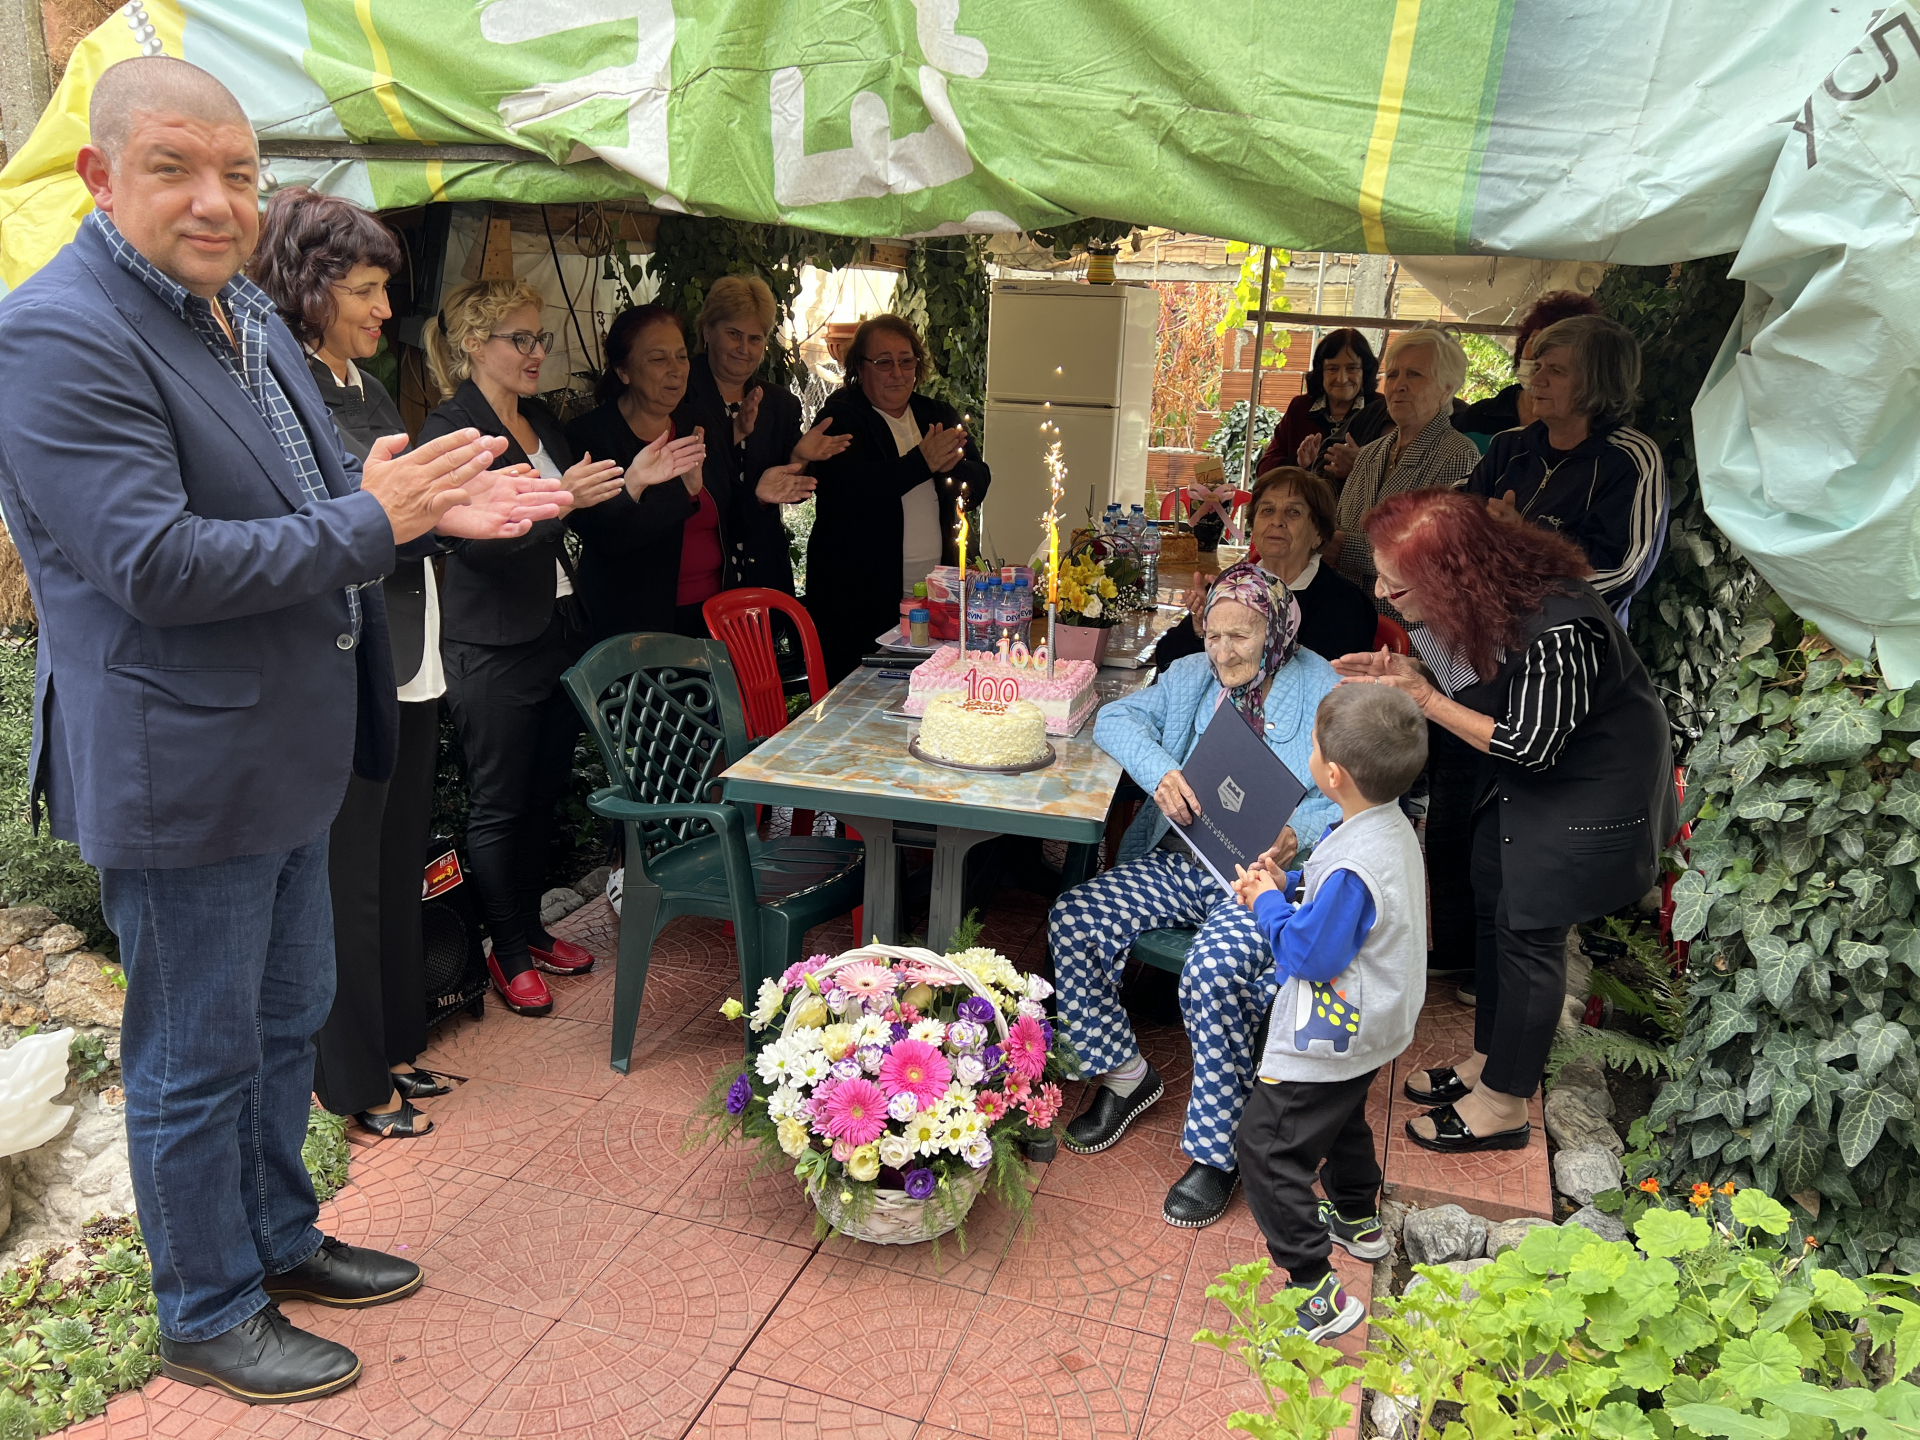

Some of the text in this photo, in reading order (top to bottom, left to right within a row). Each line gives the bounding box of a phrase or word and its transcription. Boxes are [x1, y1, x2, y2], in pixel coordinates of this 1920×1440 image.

[994, 637, 1049, 671] 100
[964, 668, 1019, 705] 100
[437, 990, 465, 1008] MBA
